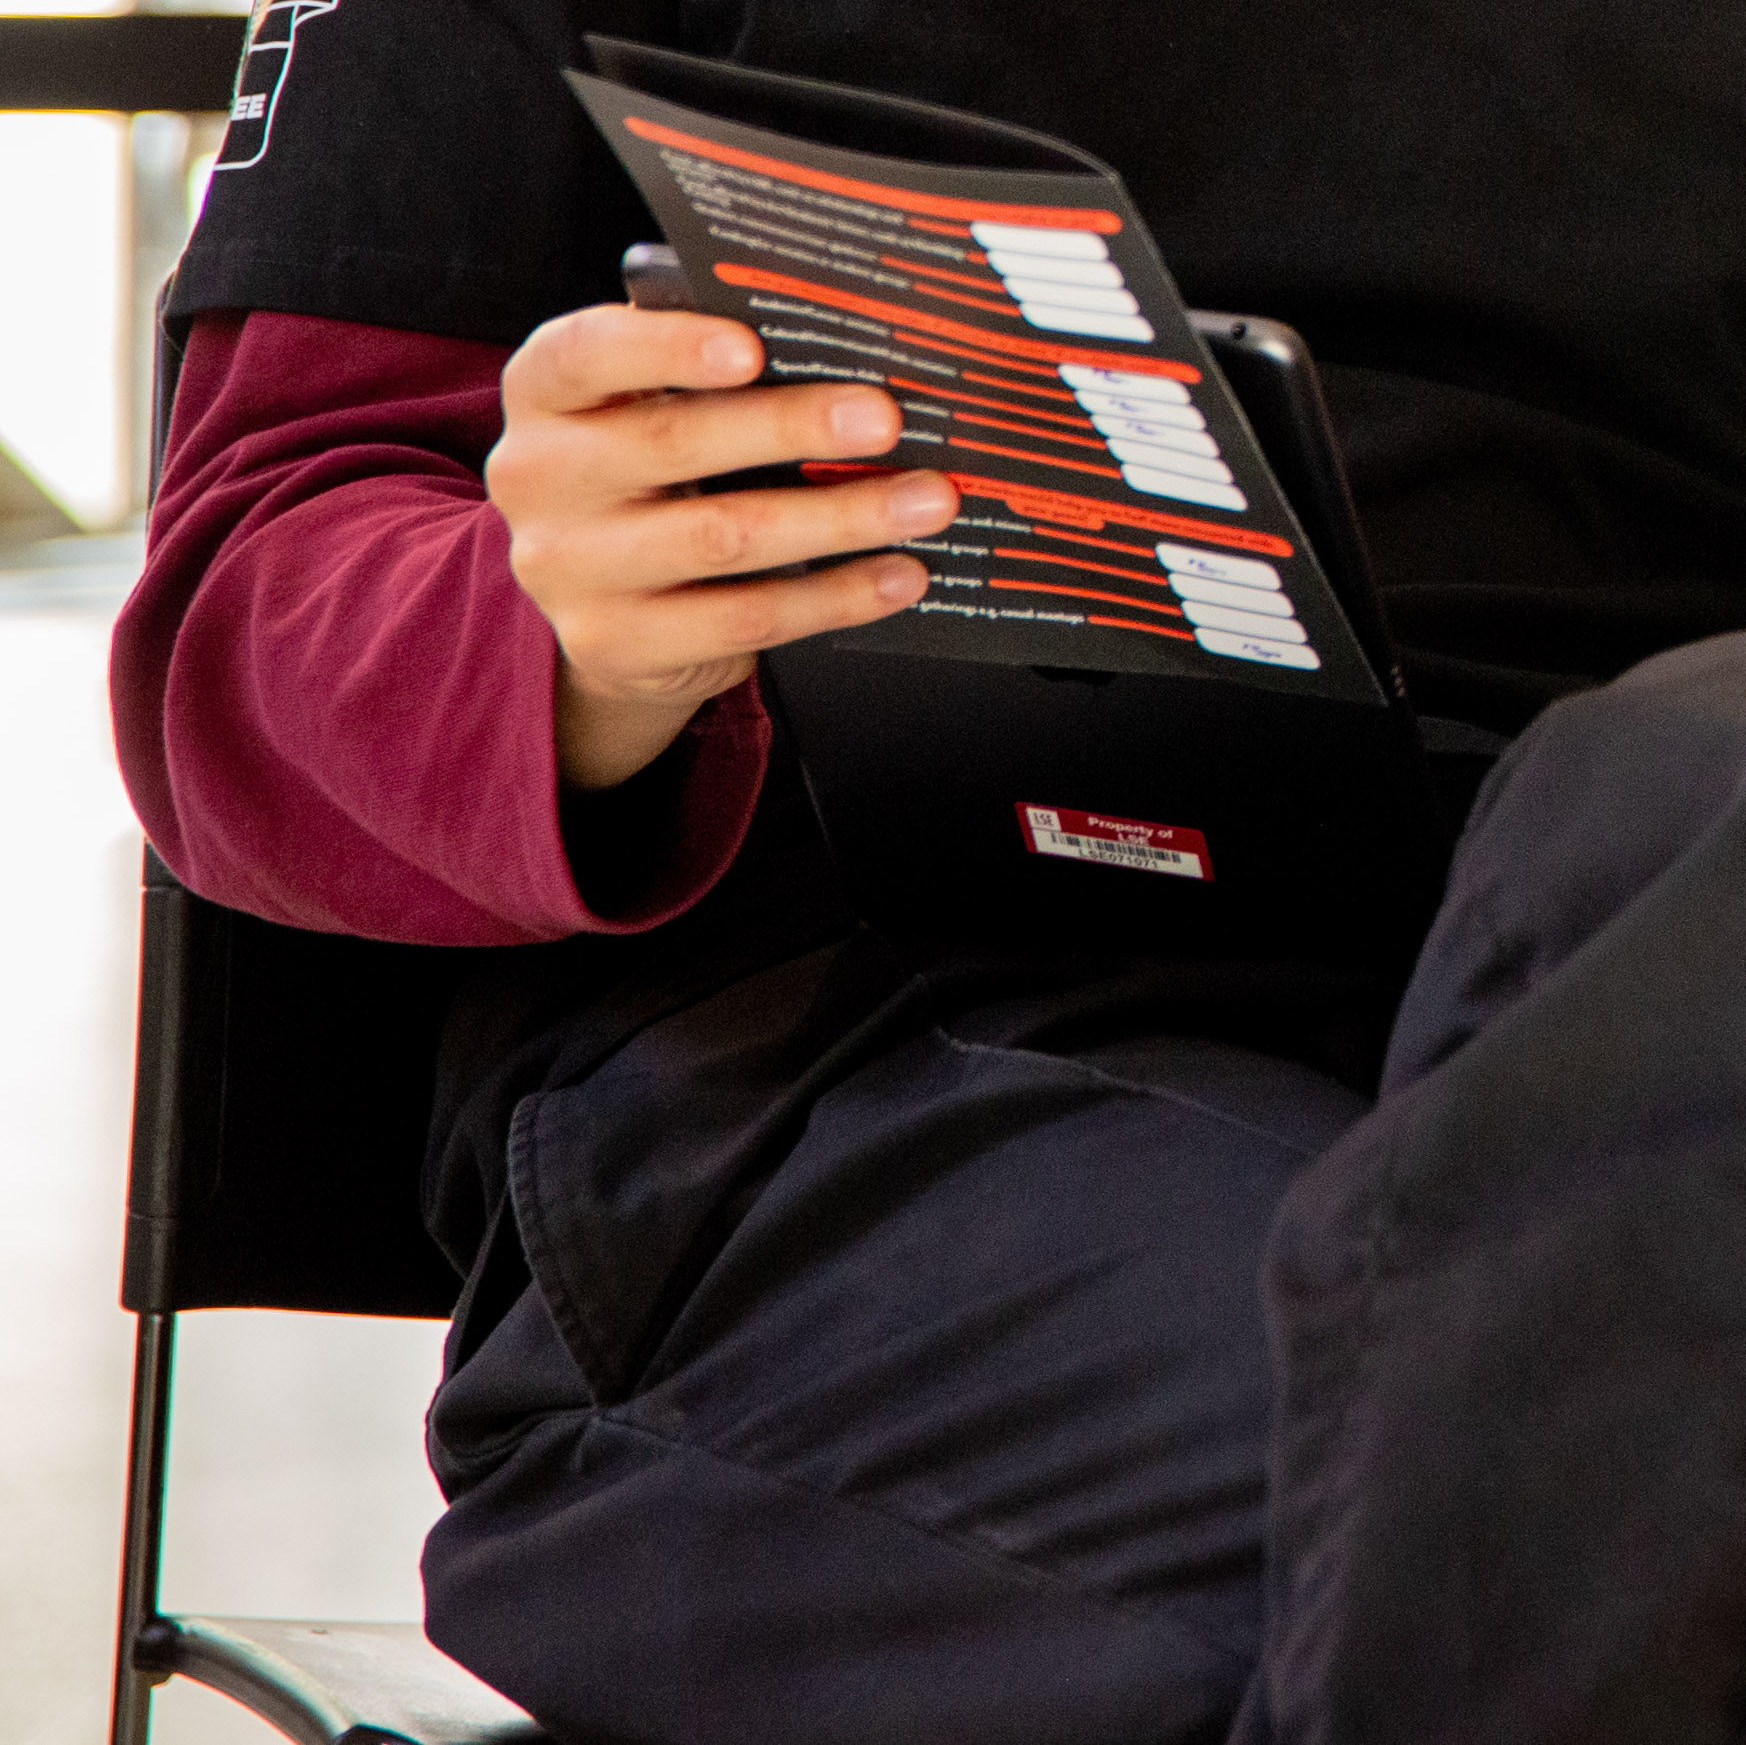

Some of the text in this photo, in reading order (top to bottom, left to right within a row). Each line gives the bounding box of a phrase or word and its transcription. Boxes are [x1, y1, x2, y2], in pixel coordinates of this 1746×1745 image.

[1033, 811, 1054, 827] LSE
[1088, 816, 1173, 840] Property of
